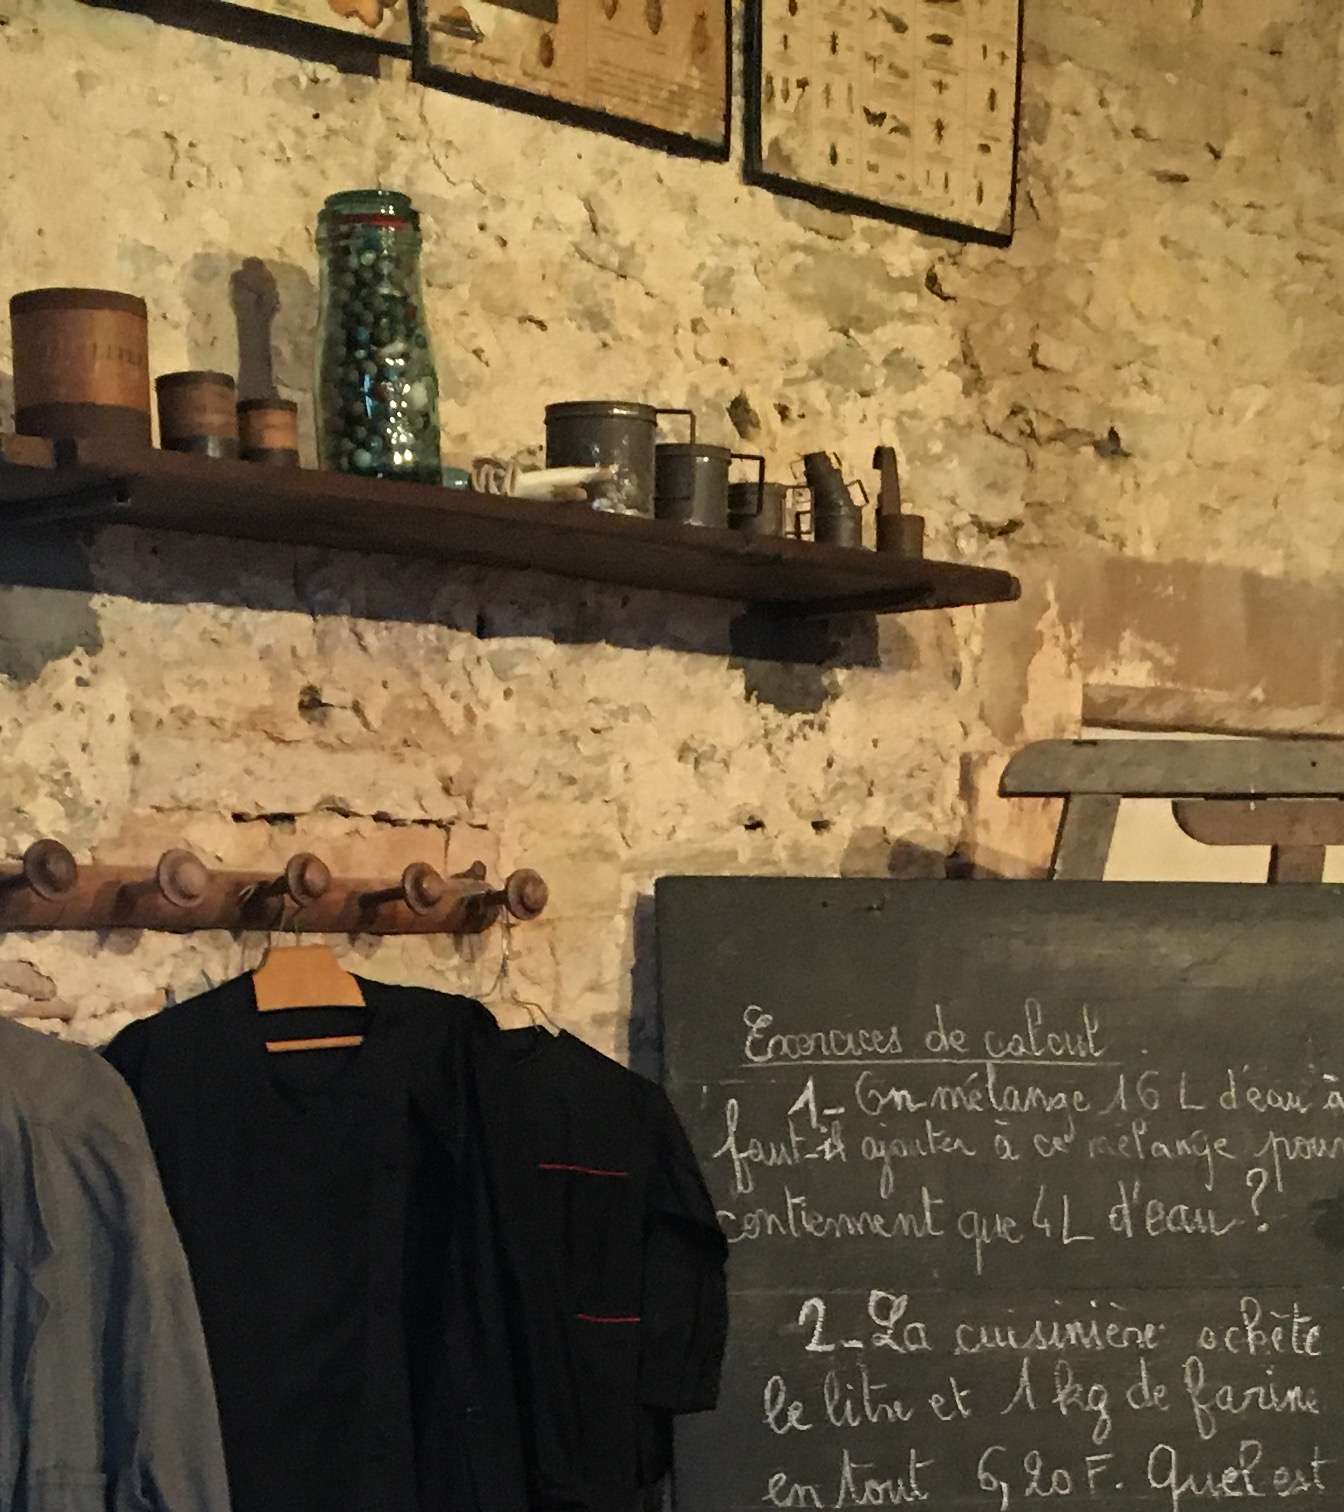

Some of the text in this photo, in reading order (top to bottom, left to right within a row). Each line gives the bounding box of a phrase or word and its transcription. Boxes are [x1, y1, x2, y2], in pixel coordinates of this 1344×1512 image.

[743, 1004, 904, 1062] Exercices
[925, 1003, 970, 1053] de
[957, 1210, 1026, 1276] que
[762, 1375, 814, 1435] le
[927, 1376, 973, 1421] et
[1126, 1356, 1170, 1412] de
[761, 1472, 824, 1509] en
[832, 1448, 936, 1509] tout
[1272, 1446, 1338, 1498] est
